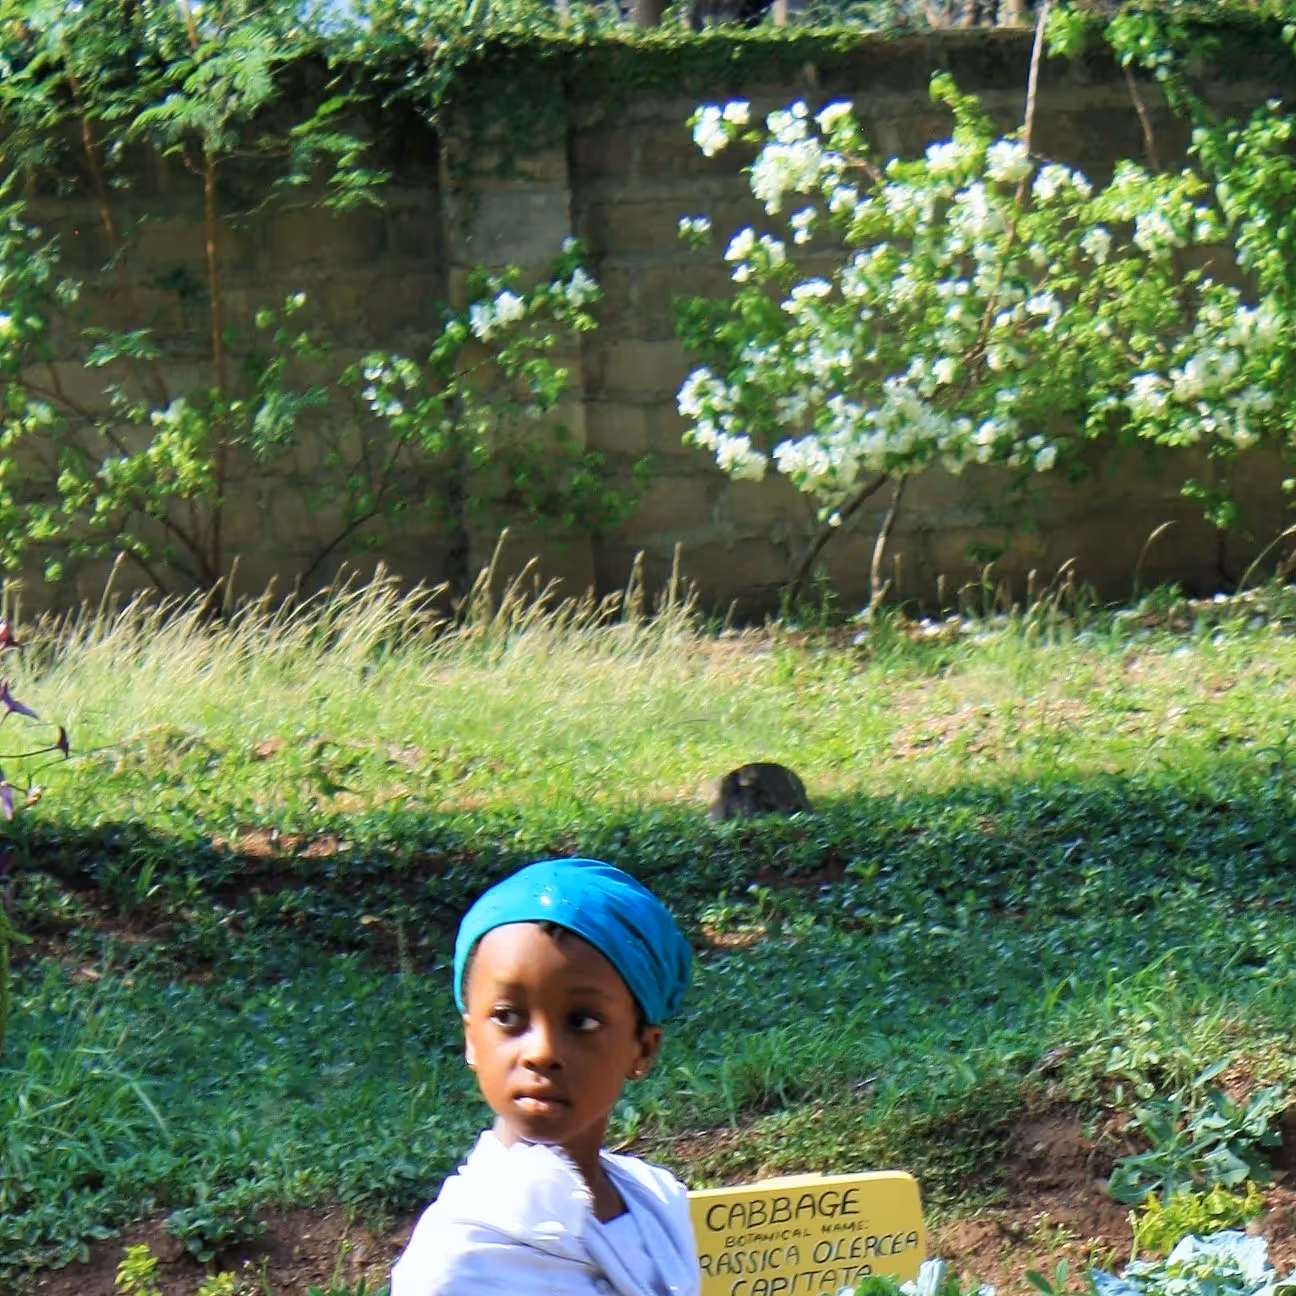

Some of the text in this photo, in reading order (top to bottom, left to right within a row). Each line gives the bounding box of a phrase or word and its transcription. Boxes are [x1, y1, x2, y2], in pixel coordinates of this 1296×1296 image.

[705, 1188, 860, 1233] CABBAGE
[724, 1228, 812, 1249] BOTANICAL
[698, 1245, 800, 1278] RASSICA
